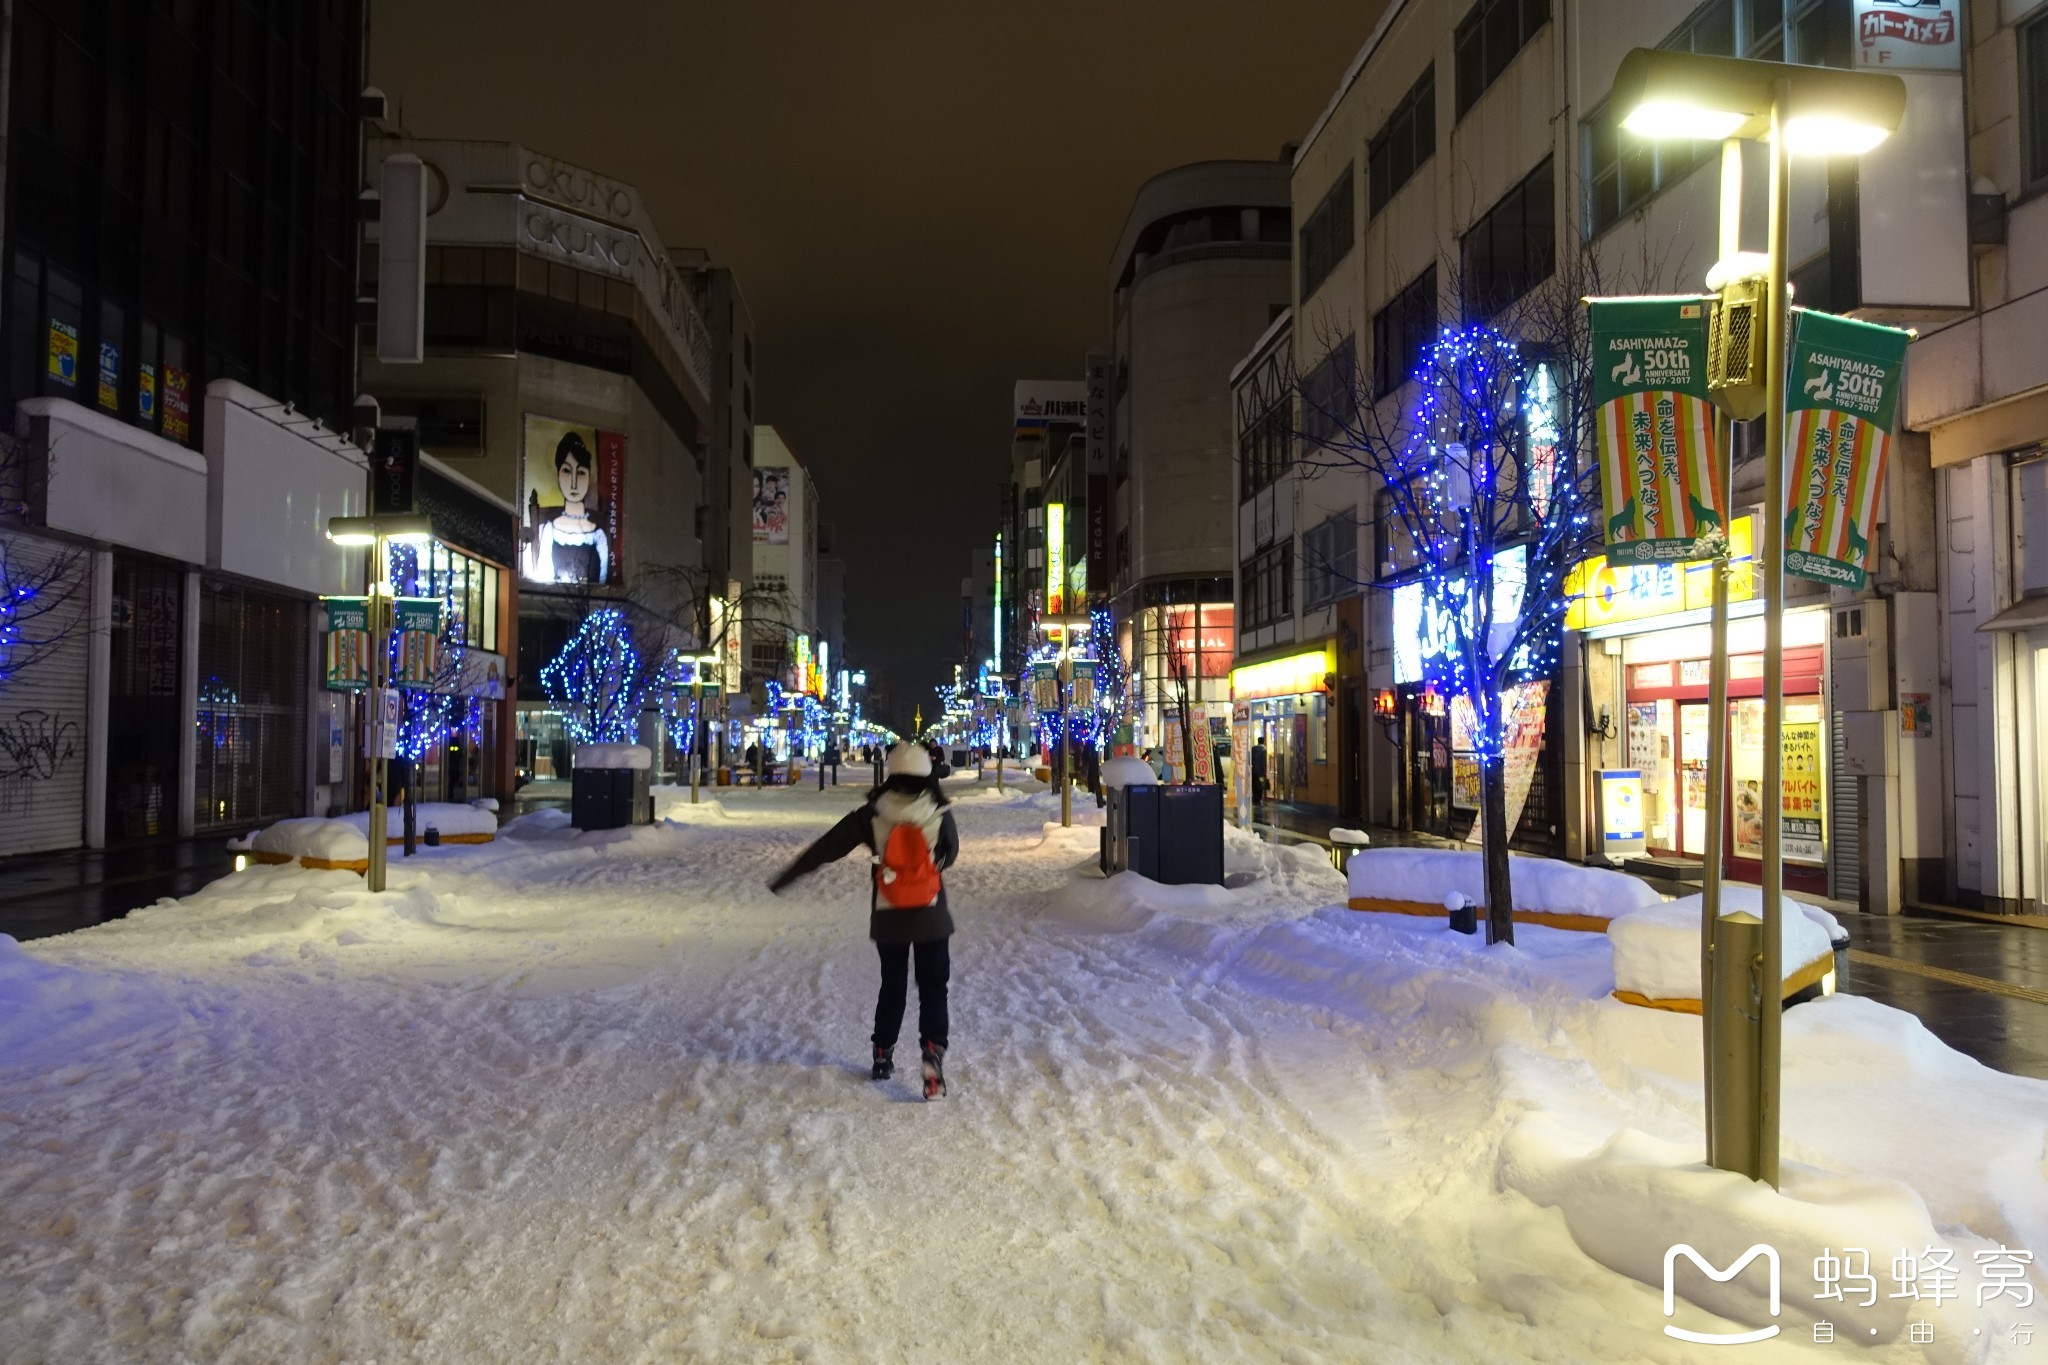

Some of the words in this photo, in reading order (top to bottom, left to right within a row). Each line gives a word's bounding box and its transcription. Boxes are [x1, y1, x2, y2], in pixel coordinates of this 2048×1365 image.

[1863, 13, 1951, 43] カトーカメラ
[526, 161, 633, 217] OKUNO
[526, 214, 631, 267] OKUNO
[1644, 350, 1690, 370] 50th
[1645, 369, 1690, 378] ANNIVERSARY
[1645, 377, 1691, 386] 1967-2017
[1837, 371, 1883, 399] 50th
[1835, 390, 1880, 406] ANNIVERSARY
[1835, 397, 1879, 414] 1967-2017
[1091, 365, 1105, 460] まなべビル
[1632, 411, 1659, 527] 未来へつなぐ
[1802, 428, 1831, 542] 未来へつなぐ
[1094, 504, 1103, 561] REGAL
[1803, 561, 1858, 584] どうぶつえん
[1781, 742, 1814, 752] きるバイト、
[1782, 796, 1812, 811] 募集中
